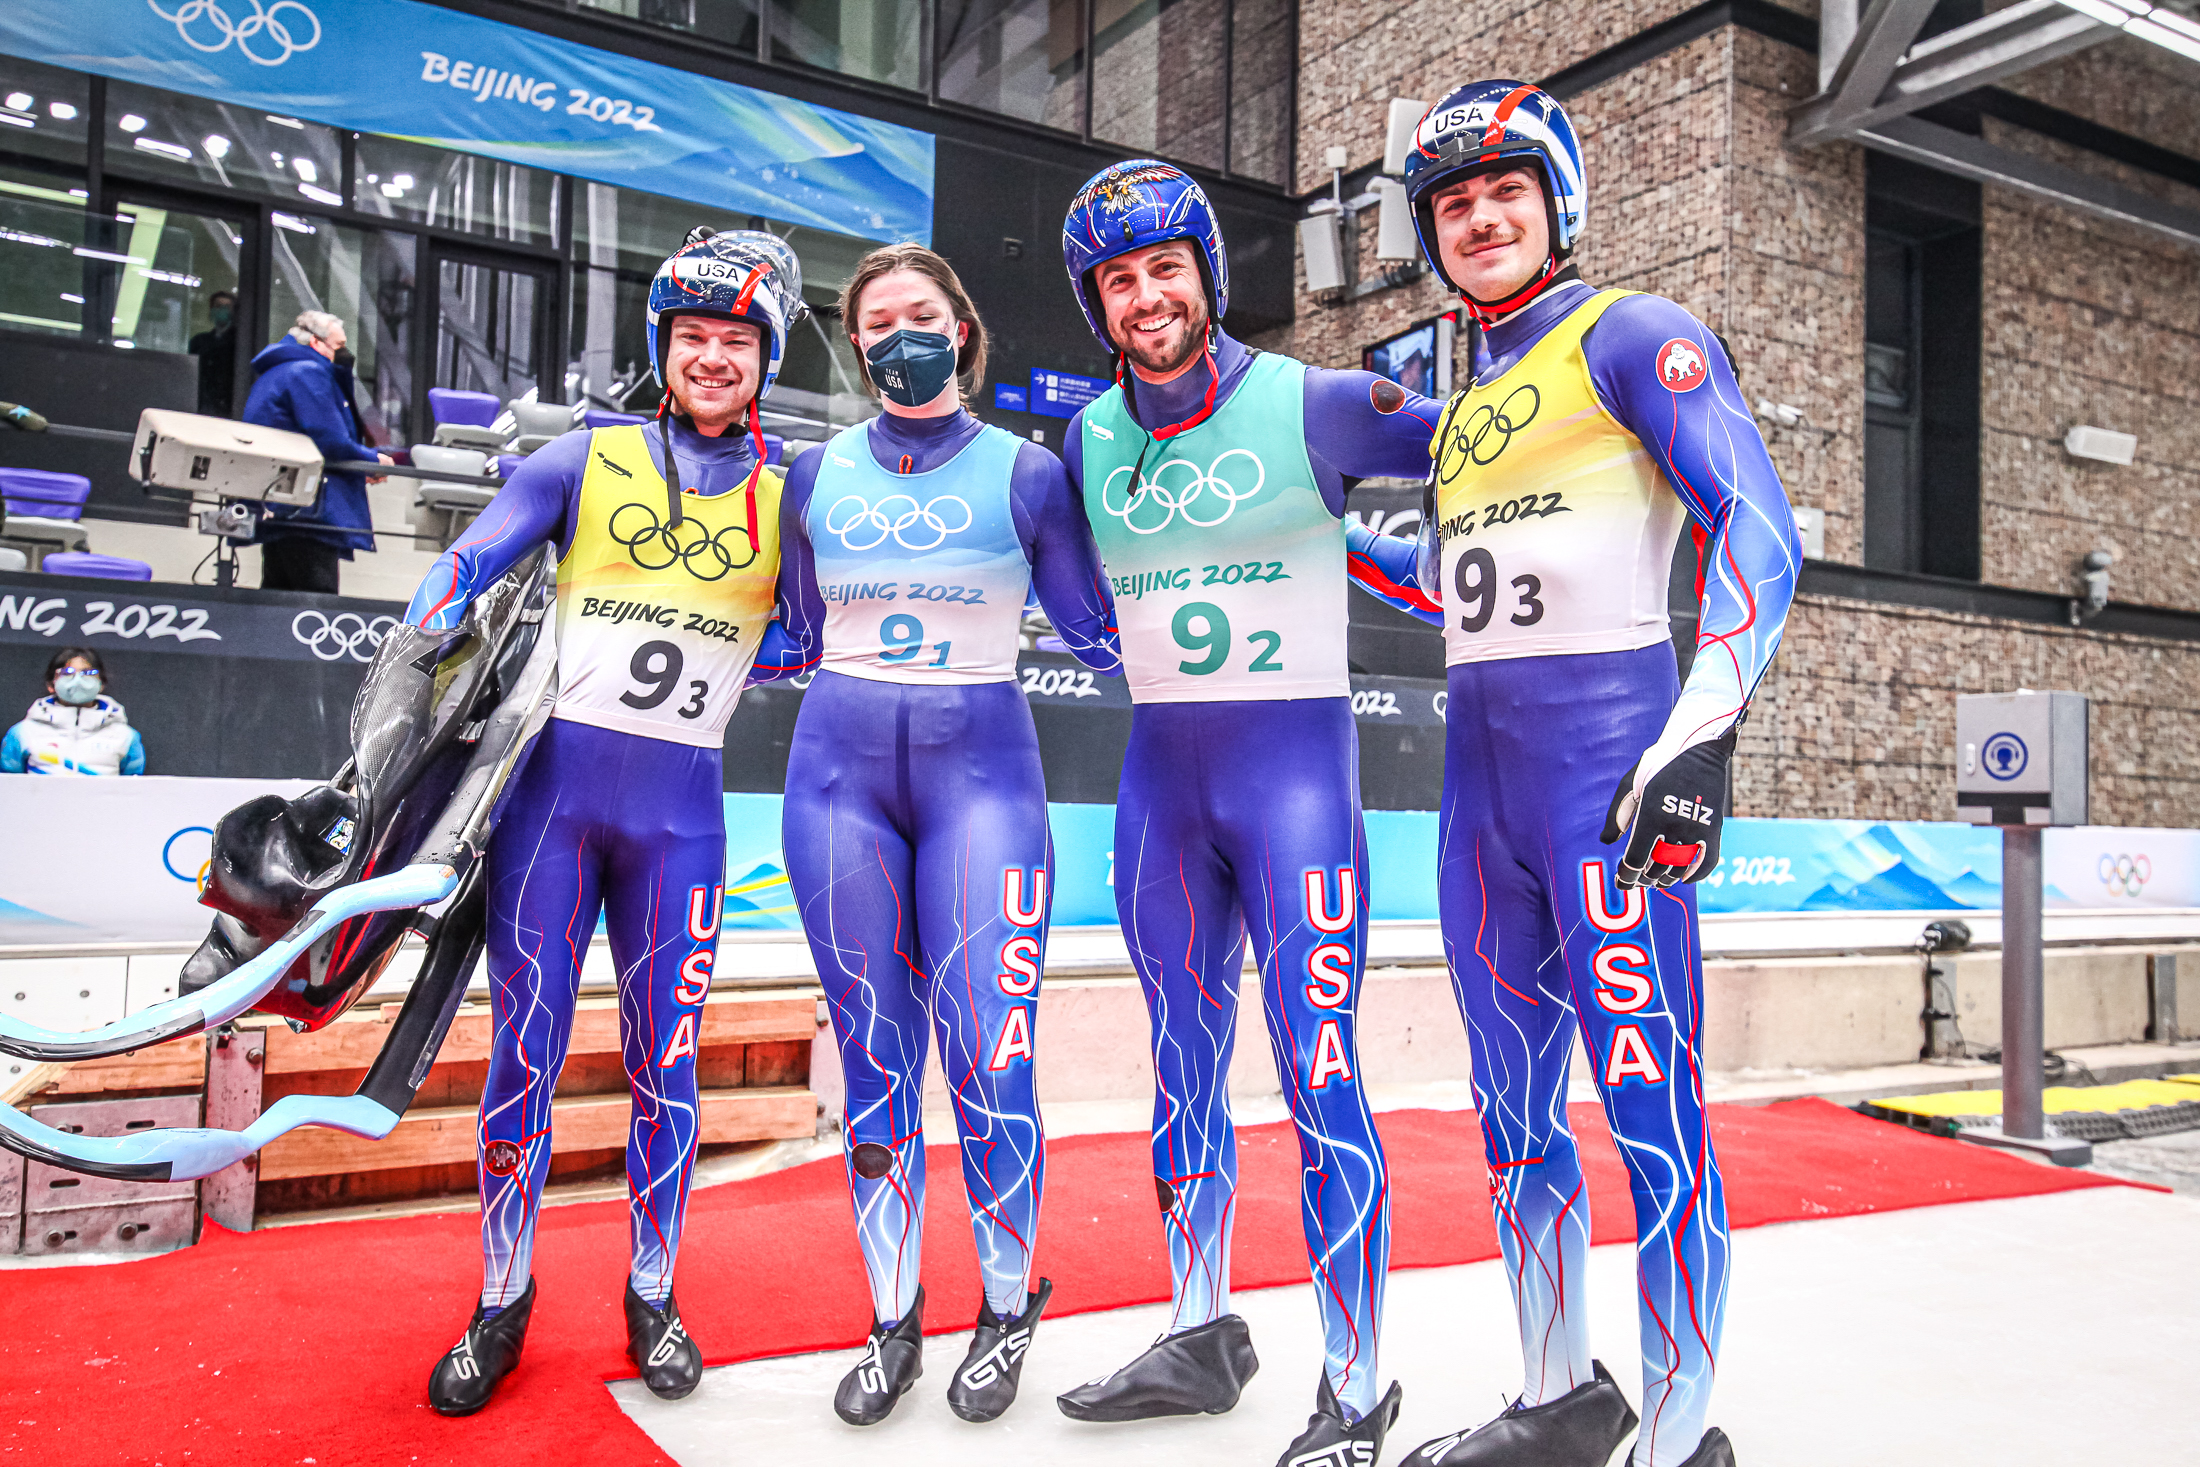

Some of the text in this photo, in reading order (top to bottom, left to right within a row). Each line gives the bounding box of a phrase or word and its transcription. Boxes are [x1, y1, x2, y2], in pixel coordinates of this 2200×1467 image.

[421, 51, 665, 133] BEIJING 2022
[1435, 106, 1484, 134] USA
[697, 263, 739, 282] USA
[884, 374, 905, 390] USA
[885, 367, 899, 376] TEAM
[1482, 492, 1573, 529] 2022
[820, 582, 988, 606] BEIJING 2022
[1112, 561, 1293, 601] BEIJING 2022
[1455, 547, 1544, 633] 9 3
[80, 601, 222, 643] 2022
[581, 597, 740, 644] BEIJING 2022
[878, 613, 952, 670] 9 1
[1171, 601, 1283, 676] 9 2
[619, 640, 709, 719] 9 3
[1022, 667, 1102, 699] 2022
[1349, 689, 1403, 718] 022
[1730, 855, 1797, 887] 2022
[658, 884, 723, 1069] USA
[988, 868, 1046, 1072] USA
[1305, 868, 1356, 1090] USA
[1582, 861, 1667, 1087] USA
[961, 1326, 1031, 1391] GTS
